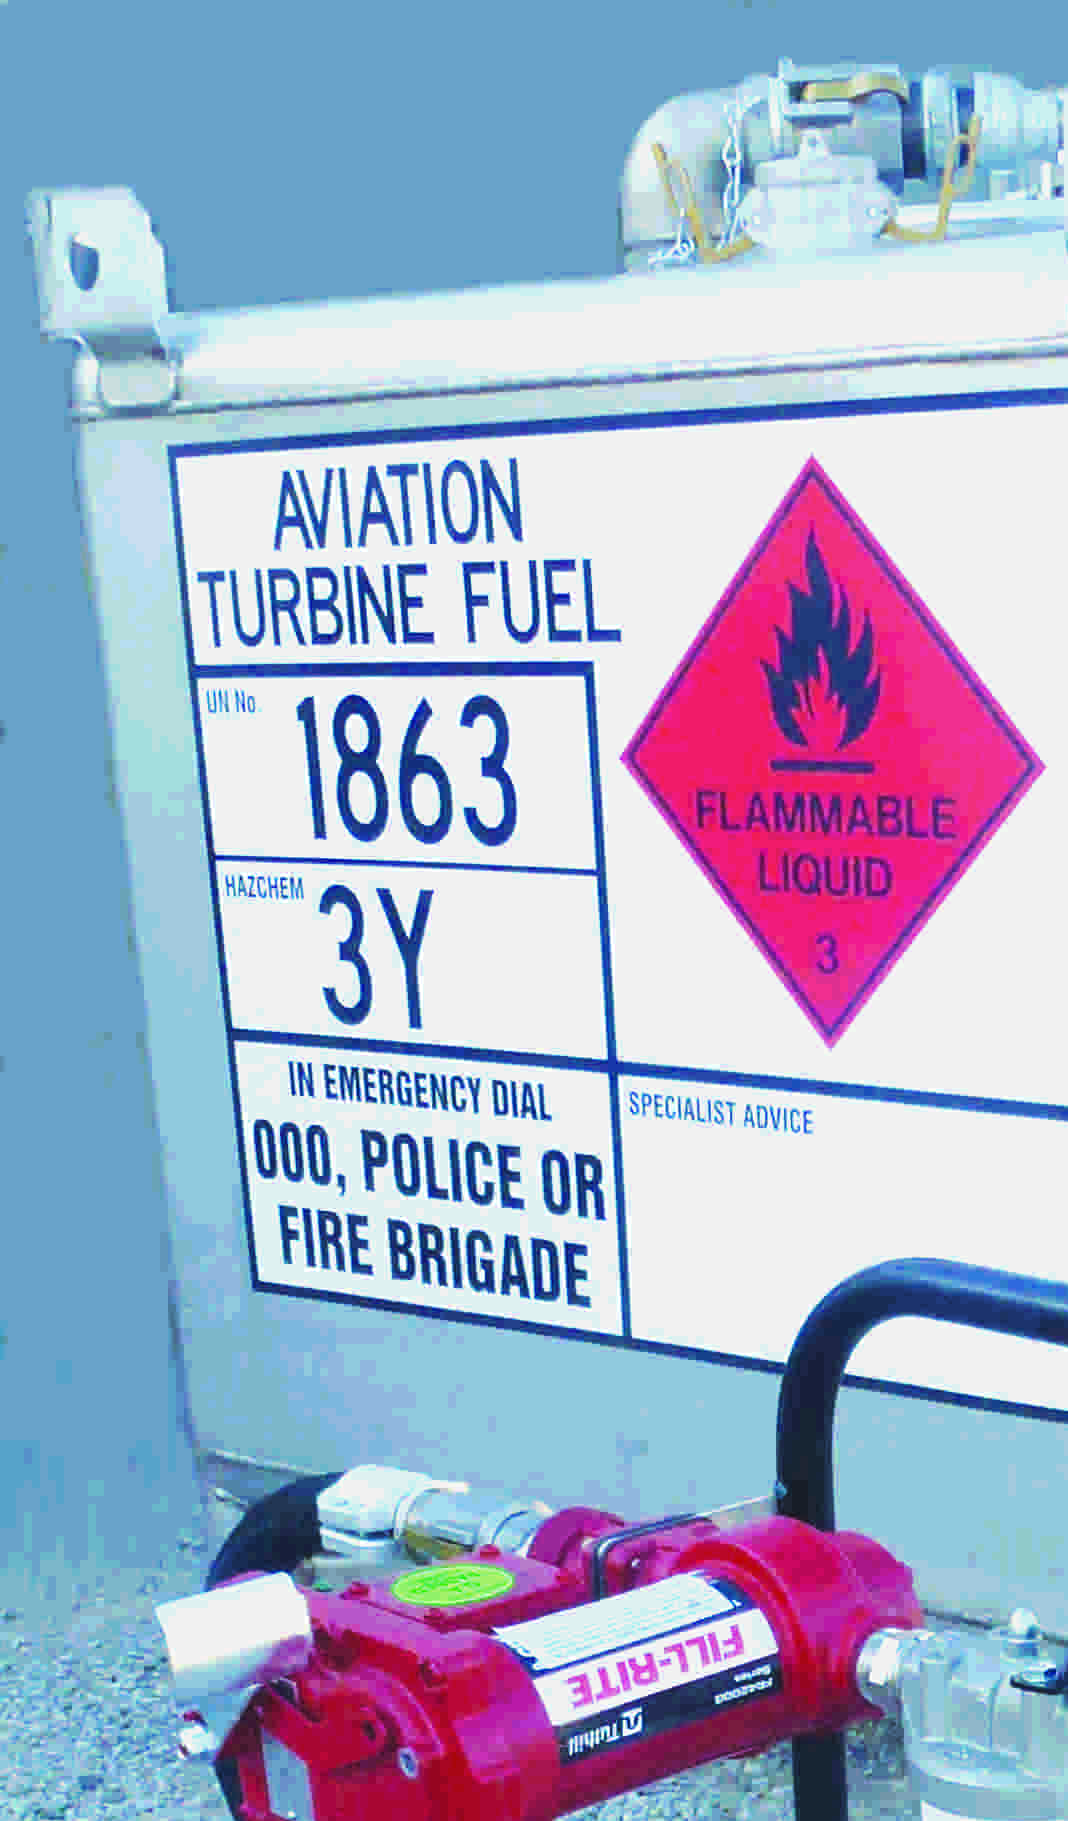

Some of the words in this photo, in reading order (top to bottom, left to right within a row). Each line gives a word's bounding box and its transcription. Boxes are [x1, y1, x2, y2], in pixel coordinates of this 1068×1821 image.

[273, 457, 524, 552] AVIATION
[196, 562, 436, 648] TURBINE
[461, 557, 623, 644] FUEL
[205, 689, 229, 714] UN
[296, 694, 518, 846] 1863
[694, 789, 959, 840] FLAMMABLE
[224, 874, 305, 901] HAZCHEM
[756, 852, 894, 898] LIQUID
[318, 883, 435, 1030] 3Y
[815, 933, 840, 975] 3
[288, 1060, 316, 1098] IN
[322, 1063, 482, 1115] EMERGENCY
[491, 1079, 553, 1122] DIAL
[629, 1091, 737, 1127] SPECIALIST
[743, 1107, 815, 1135] ADVICE
[360, 1128, 526, 1211] POLICE
[540, 1149, 607, 1222] OR
[278, 1204, 375, 1277] FIRE
[386, 1217, 593, 1308] BRIGADE
[566, 1623, 746, 1709] FILL-RITE
[567, 1722, 621, 1757] Tuthill
